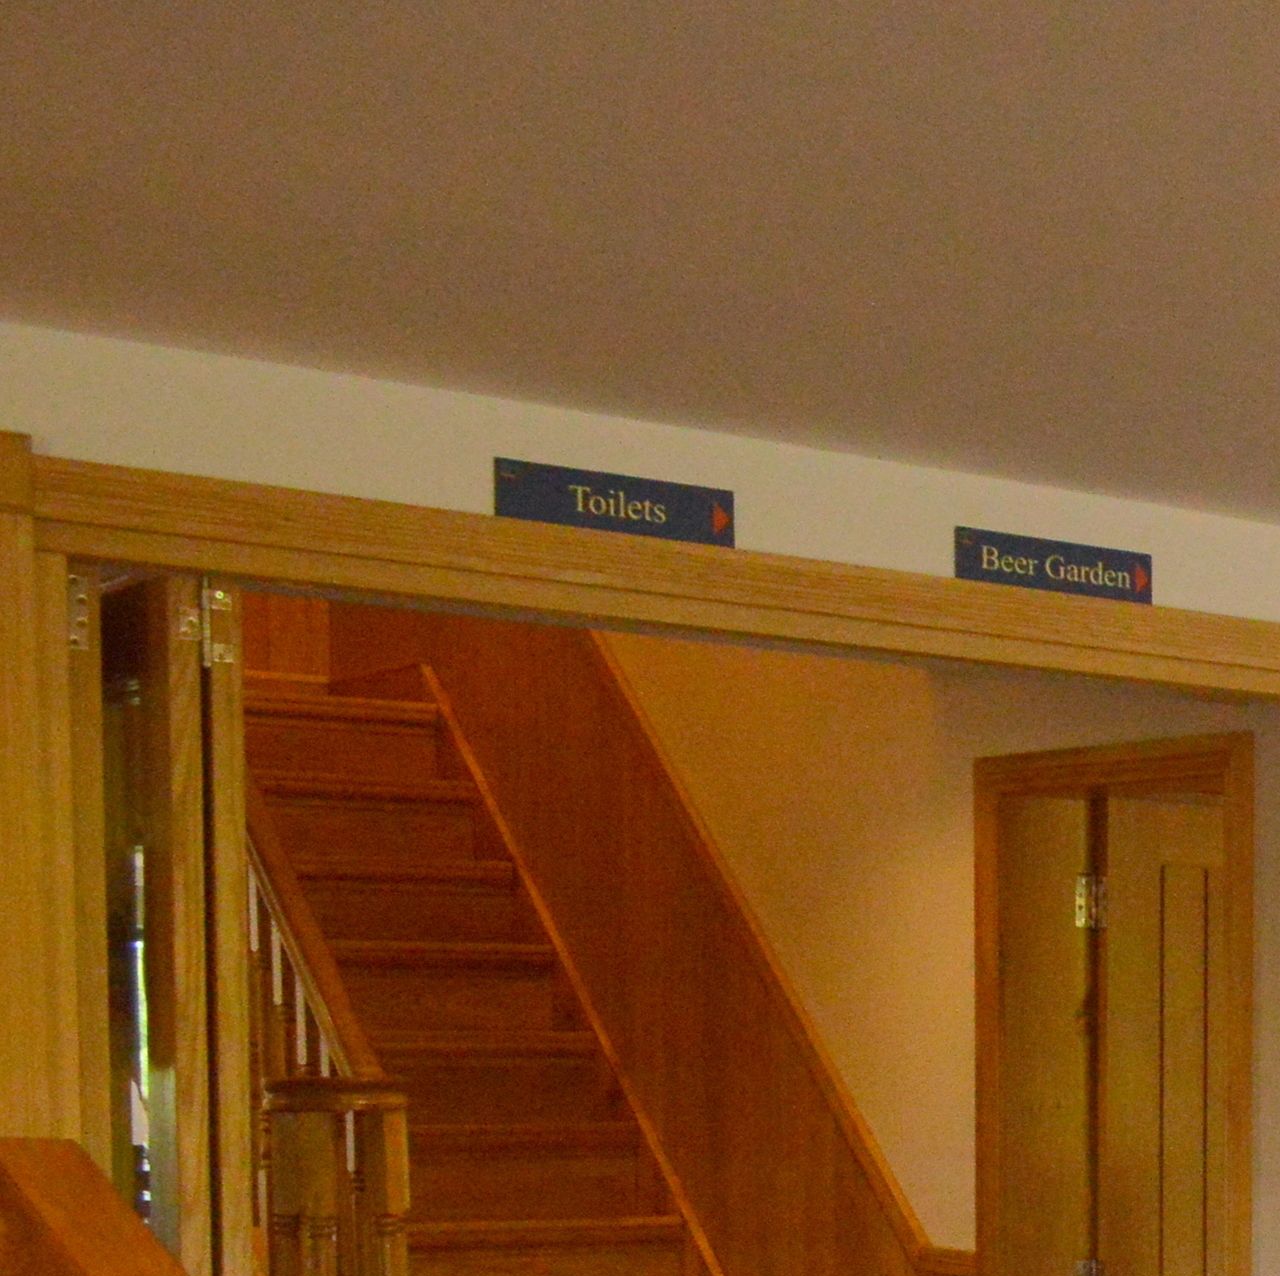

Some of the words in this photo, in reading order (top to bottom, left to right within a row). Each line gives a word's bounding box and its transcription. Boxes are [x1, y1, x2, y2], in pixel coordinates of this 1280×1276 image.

[568, 484, 666, 524] Toilets
[981, 545, 1039, 576] Beer
[1044, 554, 1131, 588] Garden
